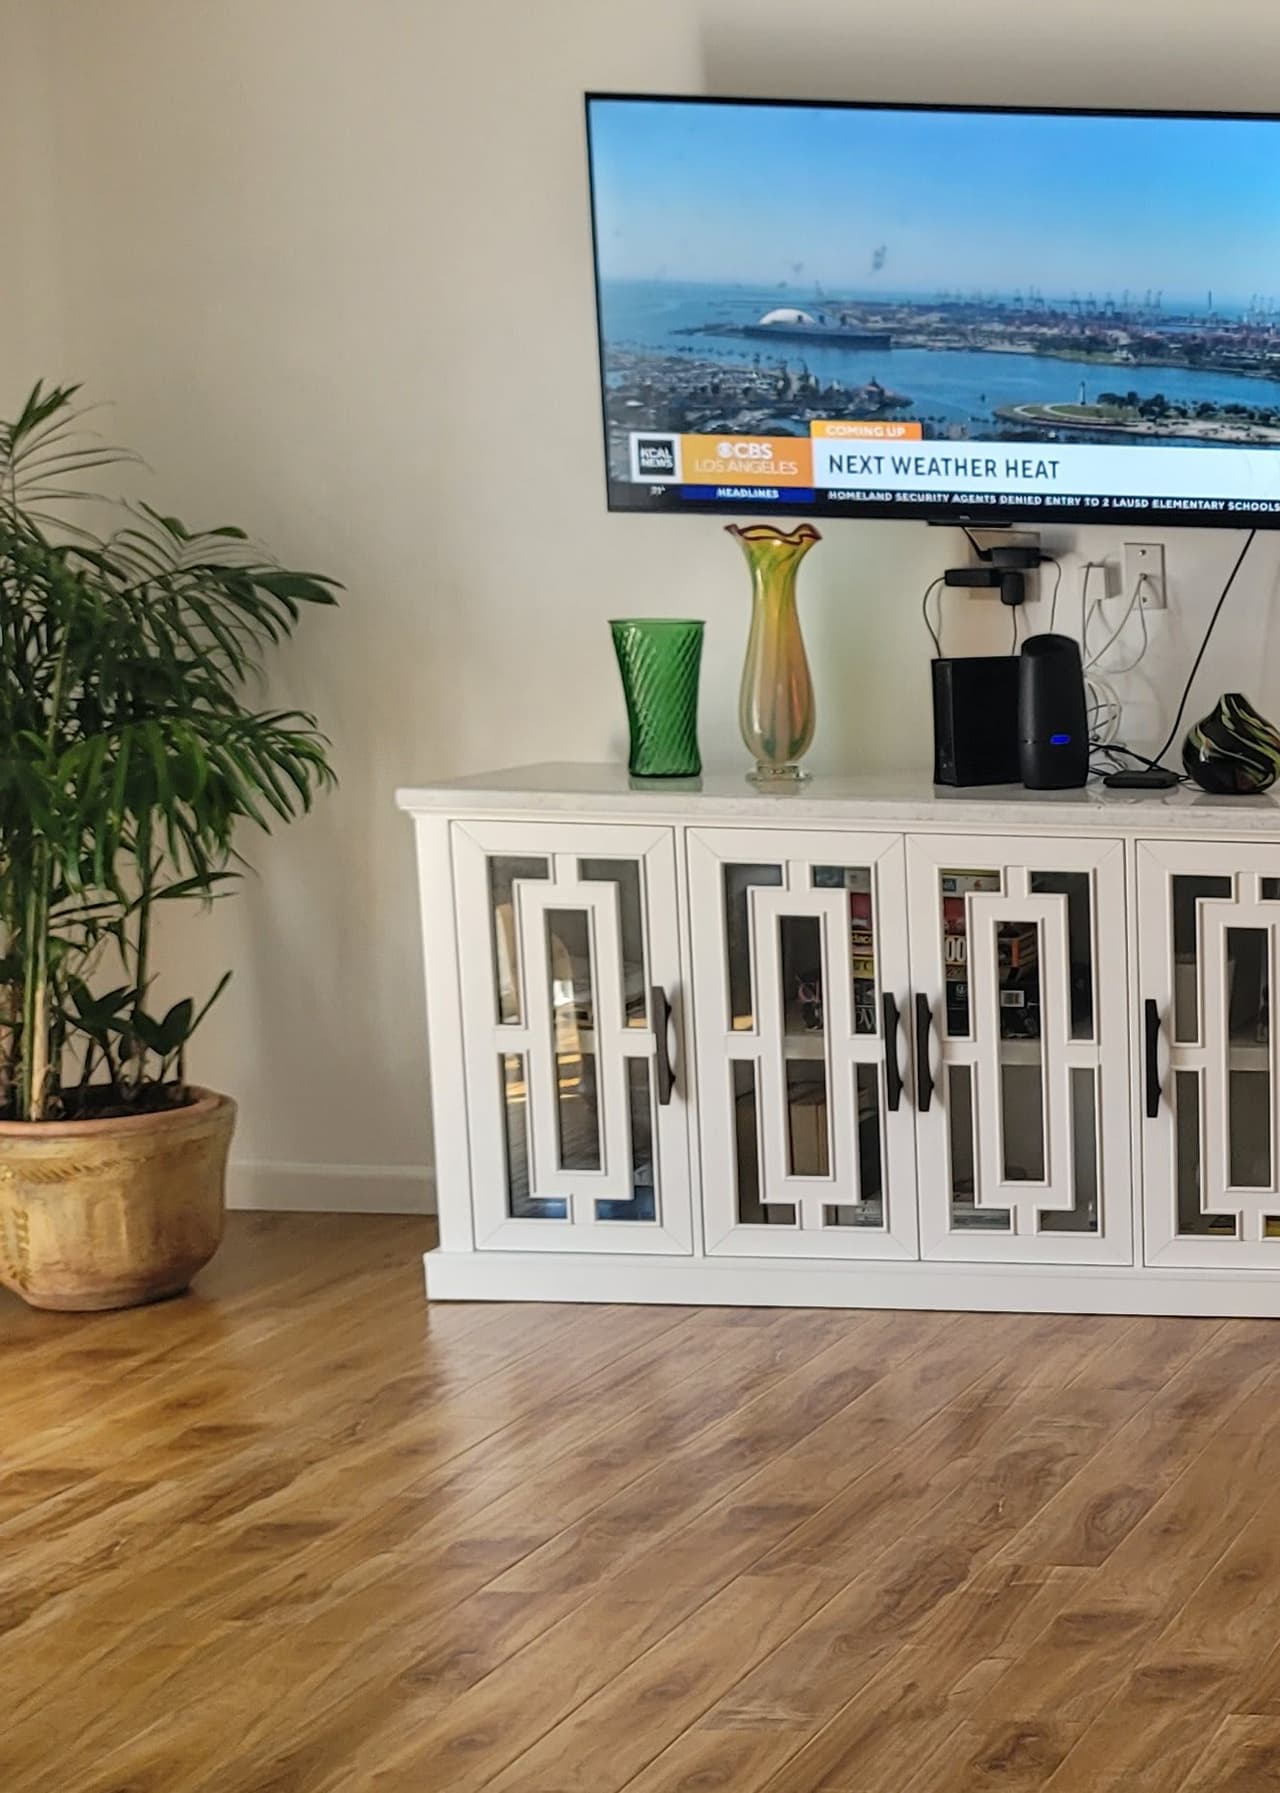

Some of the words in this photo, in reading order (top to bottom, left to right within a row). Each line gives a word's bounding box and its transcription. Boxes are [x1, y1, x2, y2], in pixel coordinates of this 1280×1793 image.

[825, 426, 884, 437] COMING
[886, 427, 906, 438] UP
[641, 447, 673, 459] KCAL
[735, 442, 774, 460] CBS
[641, 459, 674, 469] NEWS
[694, 459, 725, 474] LOS
[728, 460, 799, 476] ANGELES
[828, 454, 885, 475] NEXT
[891, 456, 998, 478] WEATHER
[1005, 459, 1060, 479] HEAT
[716, 487, 780, 499] HEADLINES
[827, 490, 893, 502] HOMELAND
[895, 493, 950, 504] SECURITY
[951, 494, 997, 505] AGENTS
[1000, 495, 1042, 506] DENIED
[1045, 496, 1081, 507] ENTRY
[1084, 497, 1100, 507] TO
[1101, 498, 1110, 508] 2
[1113, 498, 1149, 509] LAUSD
[1152, 499, 1225, 511] ELEMENTARY
